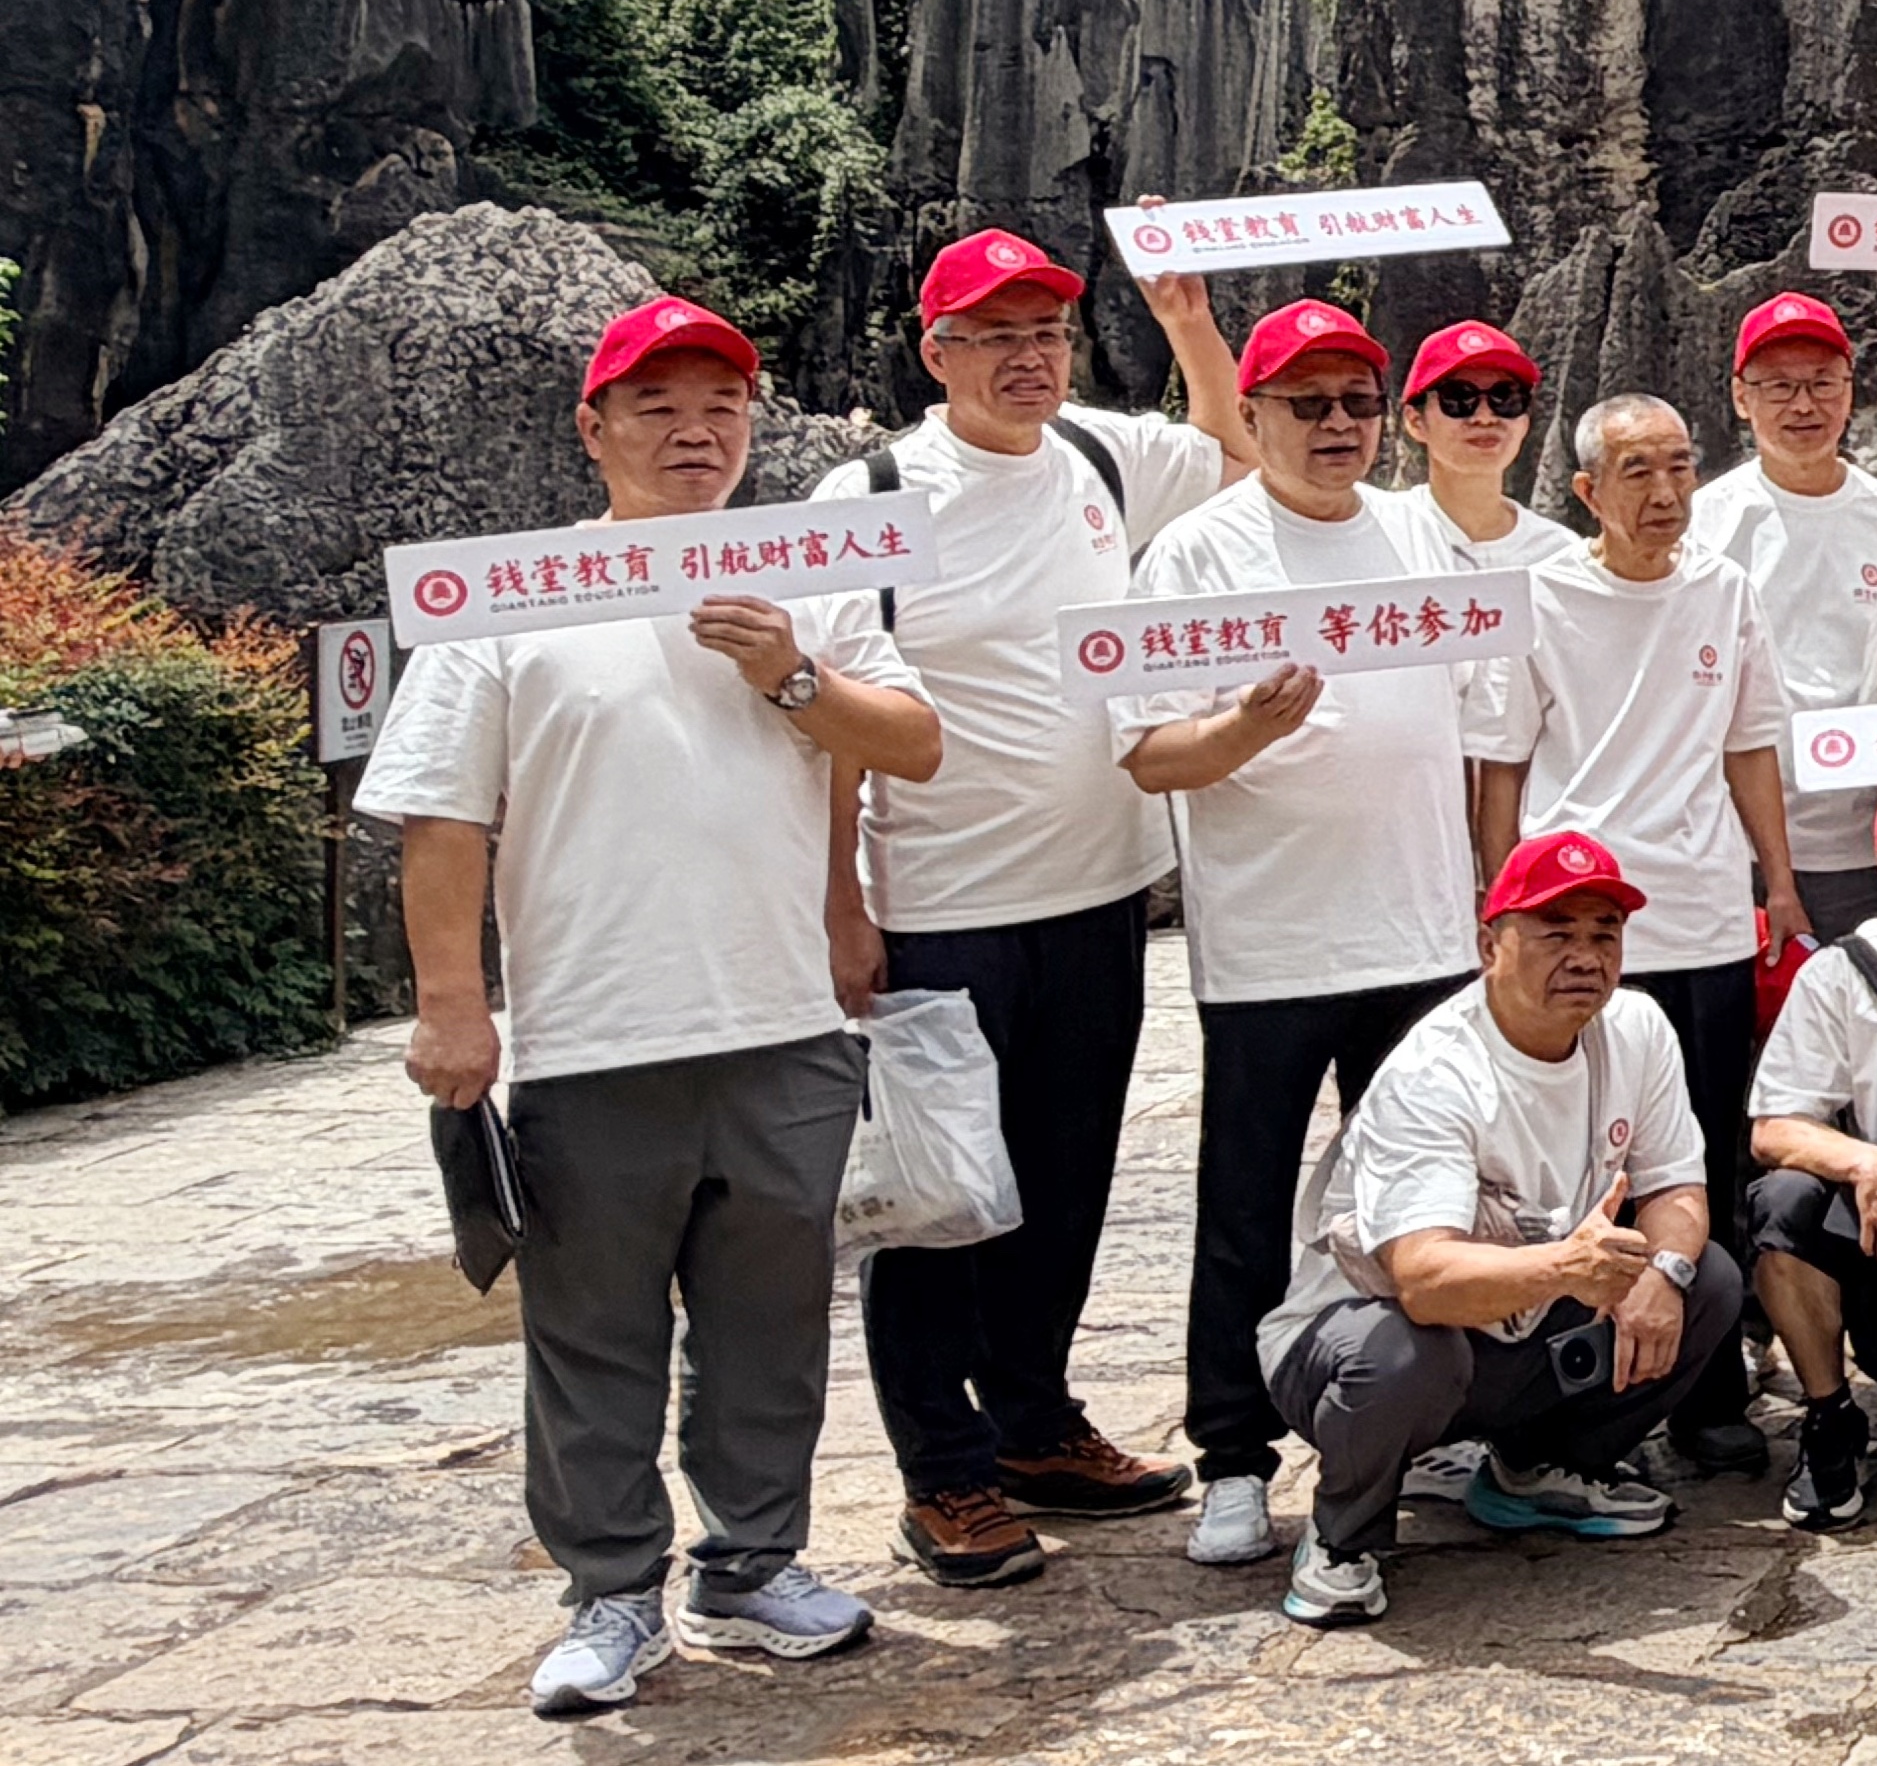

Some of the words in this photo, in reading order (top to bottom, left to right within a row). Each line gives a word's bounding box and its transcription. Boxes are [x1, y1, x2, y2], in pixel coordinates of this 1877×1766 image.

[1319, 203, 1484, 237] 引航财富人生
[485, 544, 656, 597] 钱堂教育
[680, 521, 913, 581] 引航财富人生
[1140, 611, 1289, 659] 钱堂教育
[1318, 595, 1504, 655] 等你参加
